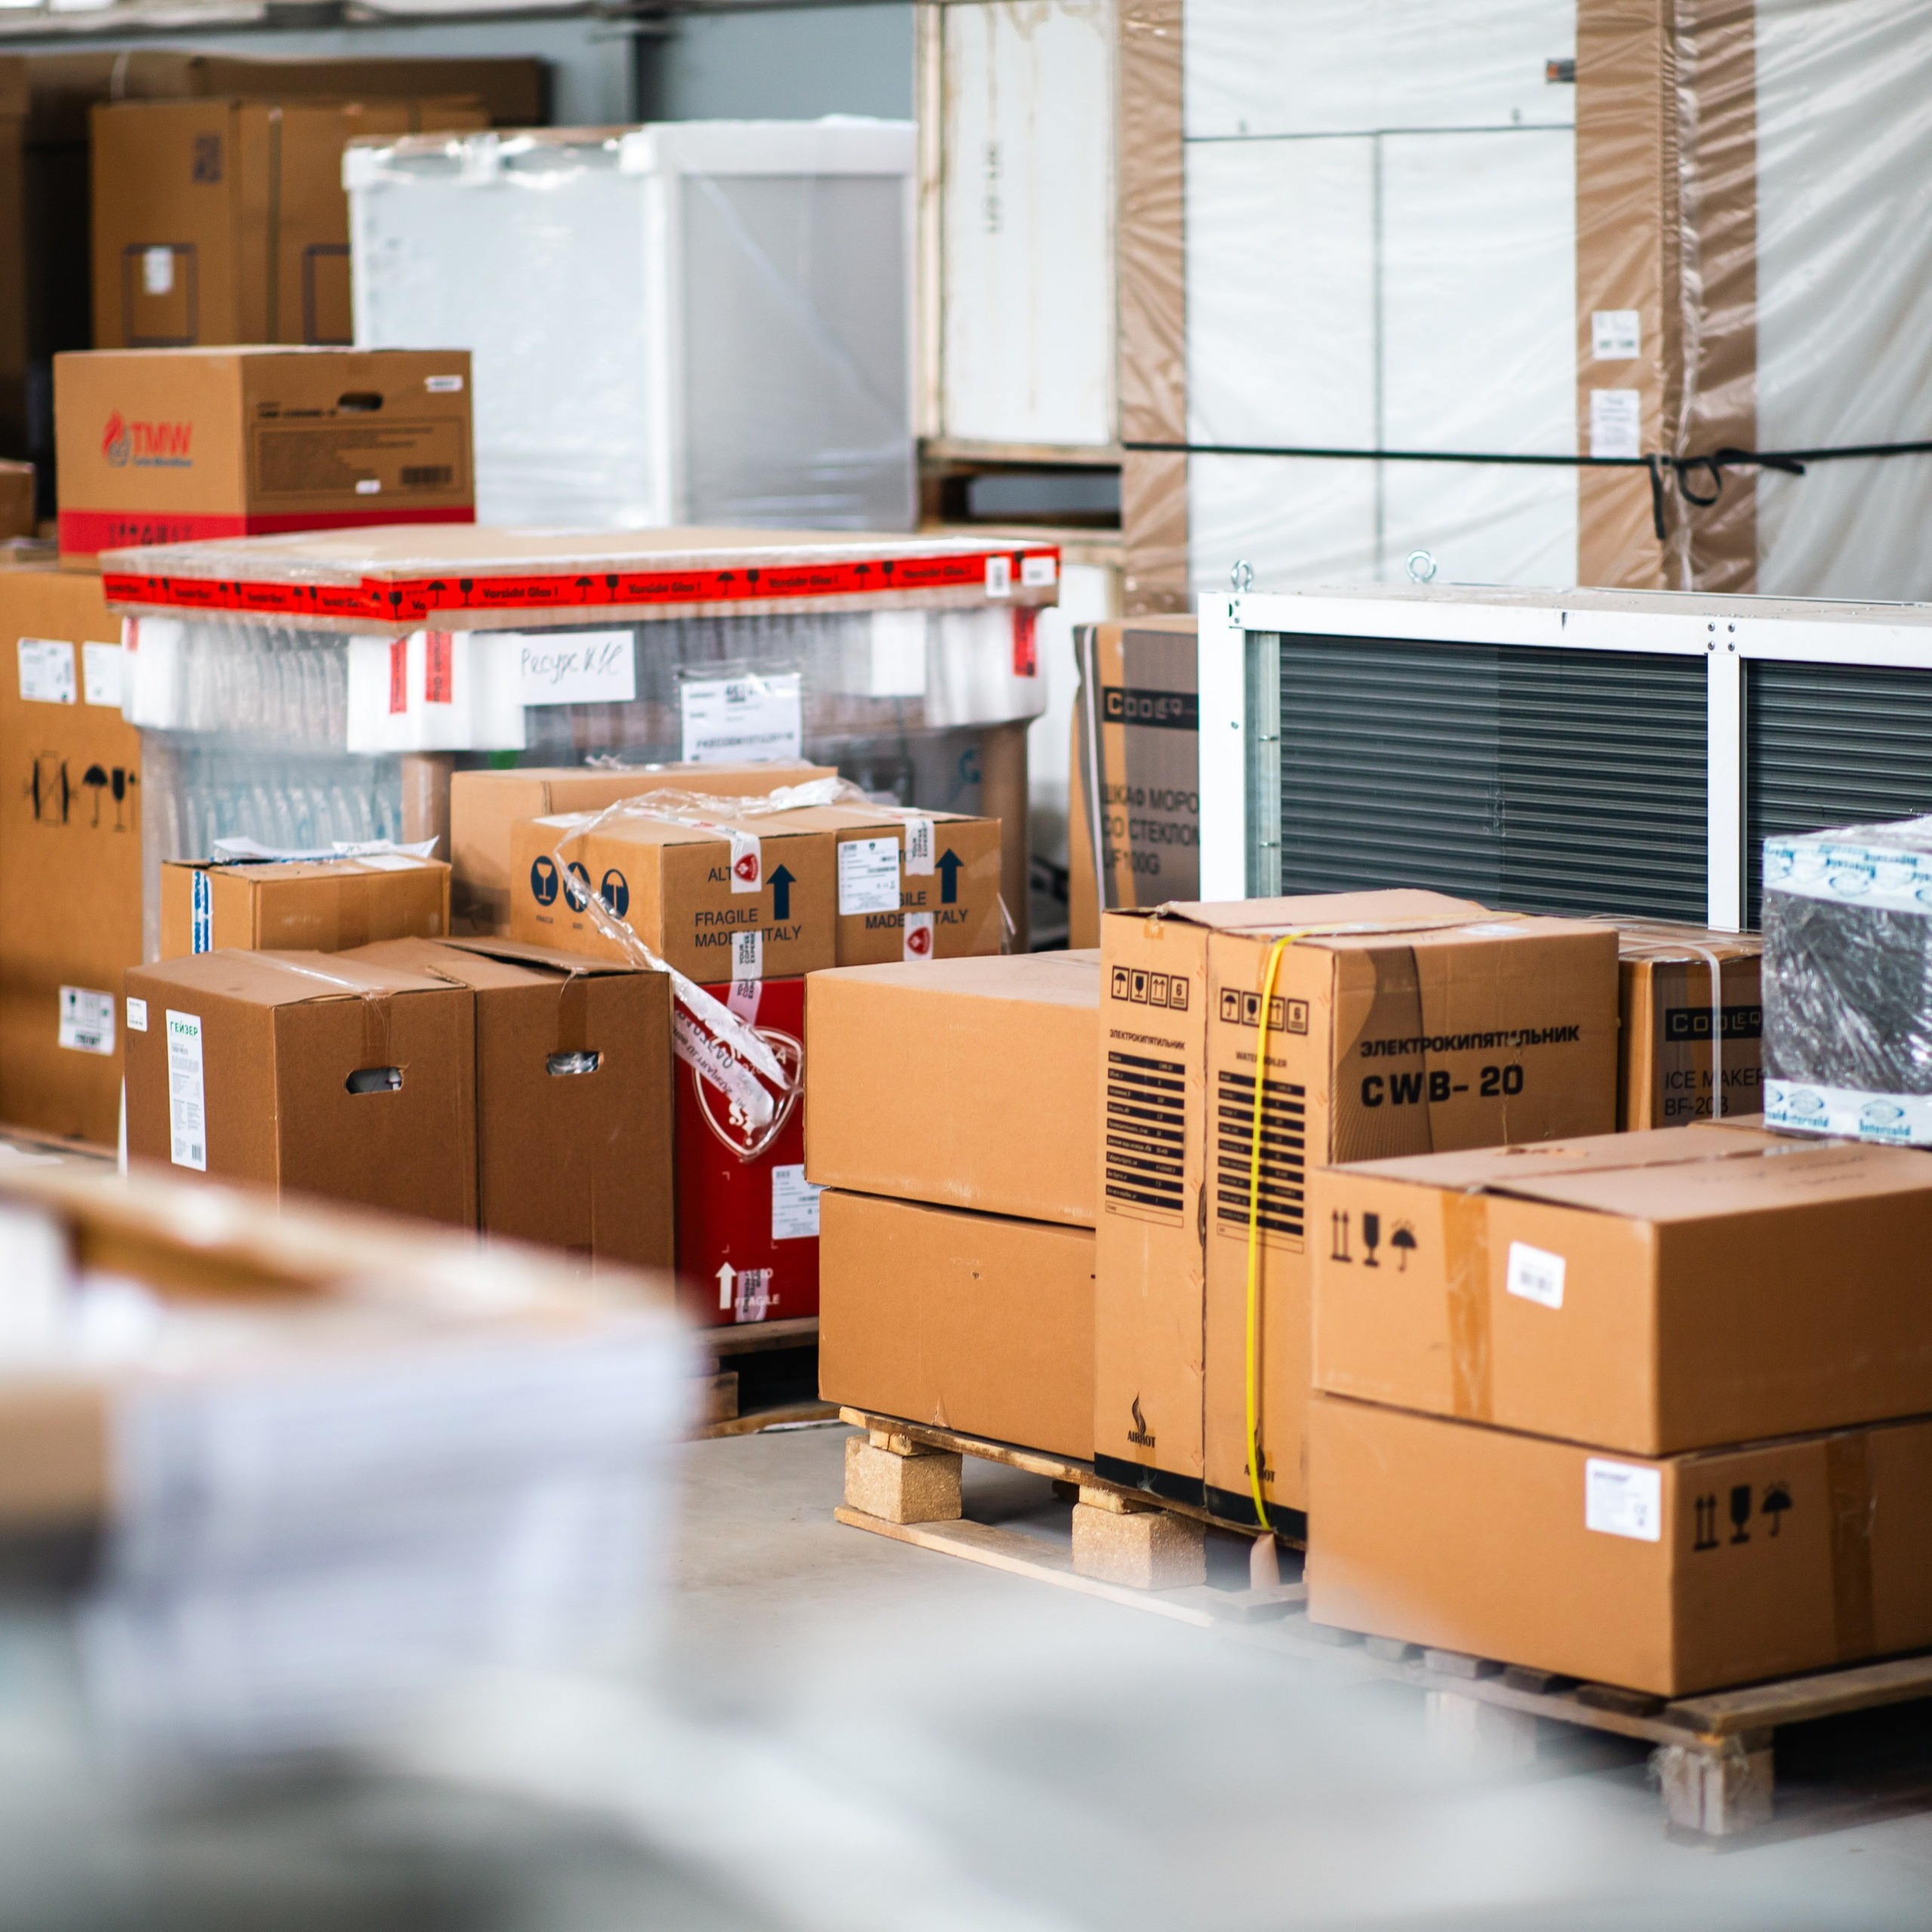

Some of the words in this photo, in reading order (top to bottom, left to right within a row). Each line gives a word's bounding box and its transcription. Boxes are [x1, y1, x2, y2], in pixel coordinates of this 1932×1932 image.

[131, 422, 192, 455] TMW
[708, 866, 731, 882] ALT
[695, 908, 758, 927] FRAGILE
[866, 913, 905, 929] MADE
[932, 909, 968, 924] TALY
[170, 1020, 198, 1036] ГЕЙЗЕР
[1361, 1025, 1580, 1057] ЭЛЕКТРОКИПЯТИЛЬНИК
[1665, 1071, 1696, 1089] ICE
[1128, 1430, 1155, 1448] AIRHOT
